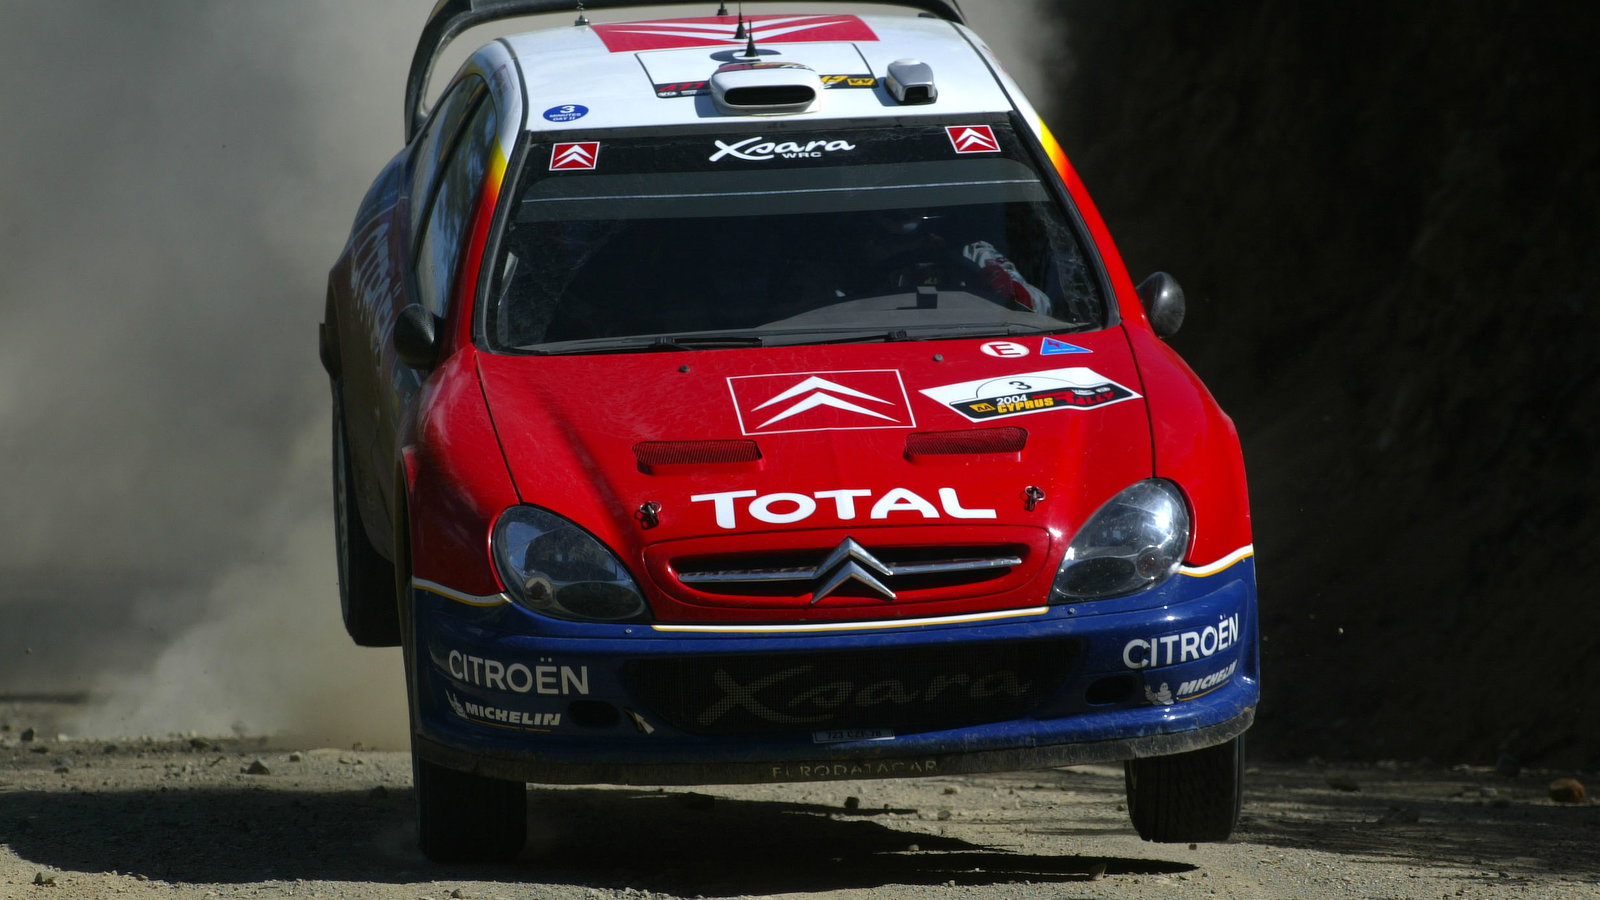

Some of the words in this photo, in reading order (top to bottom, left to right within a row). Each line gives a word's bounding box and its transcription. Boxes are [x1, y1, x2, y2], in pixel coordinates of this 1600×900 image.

[560, 106, 576, 114] 3
[709, 136, 856, 162] Xsara
[782, 151, 822, 159] WRC
[989, 344, 1021, 356] E
[1009, 381, 1032, 390] 3
[996, 394, 1028, 406] 2004
[997, 397, 1054, 414] CYPRUS
[1032, 391, 1115, 406] RALLY
[690, 487, 997, 529] TOTAL
[1122, 612, 1239, 670] CITROËN
[449, 650, 589, 695] CITROËN
[1176, 659, 1238, 695] MICHELIN
[697, 665, 1033, 725] Xsara
[465, 702, 561, 726] MICHELIN
